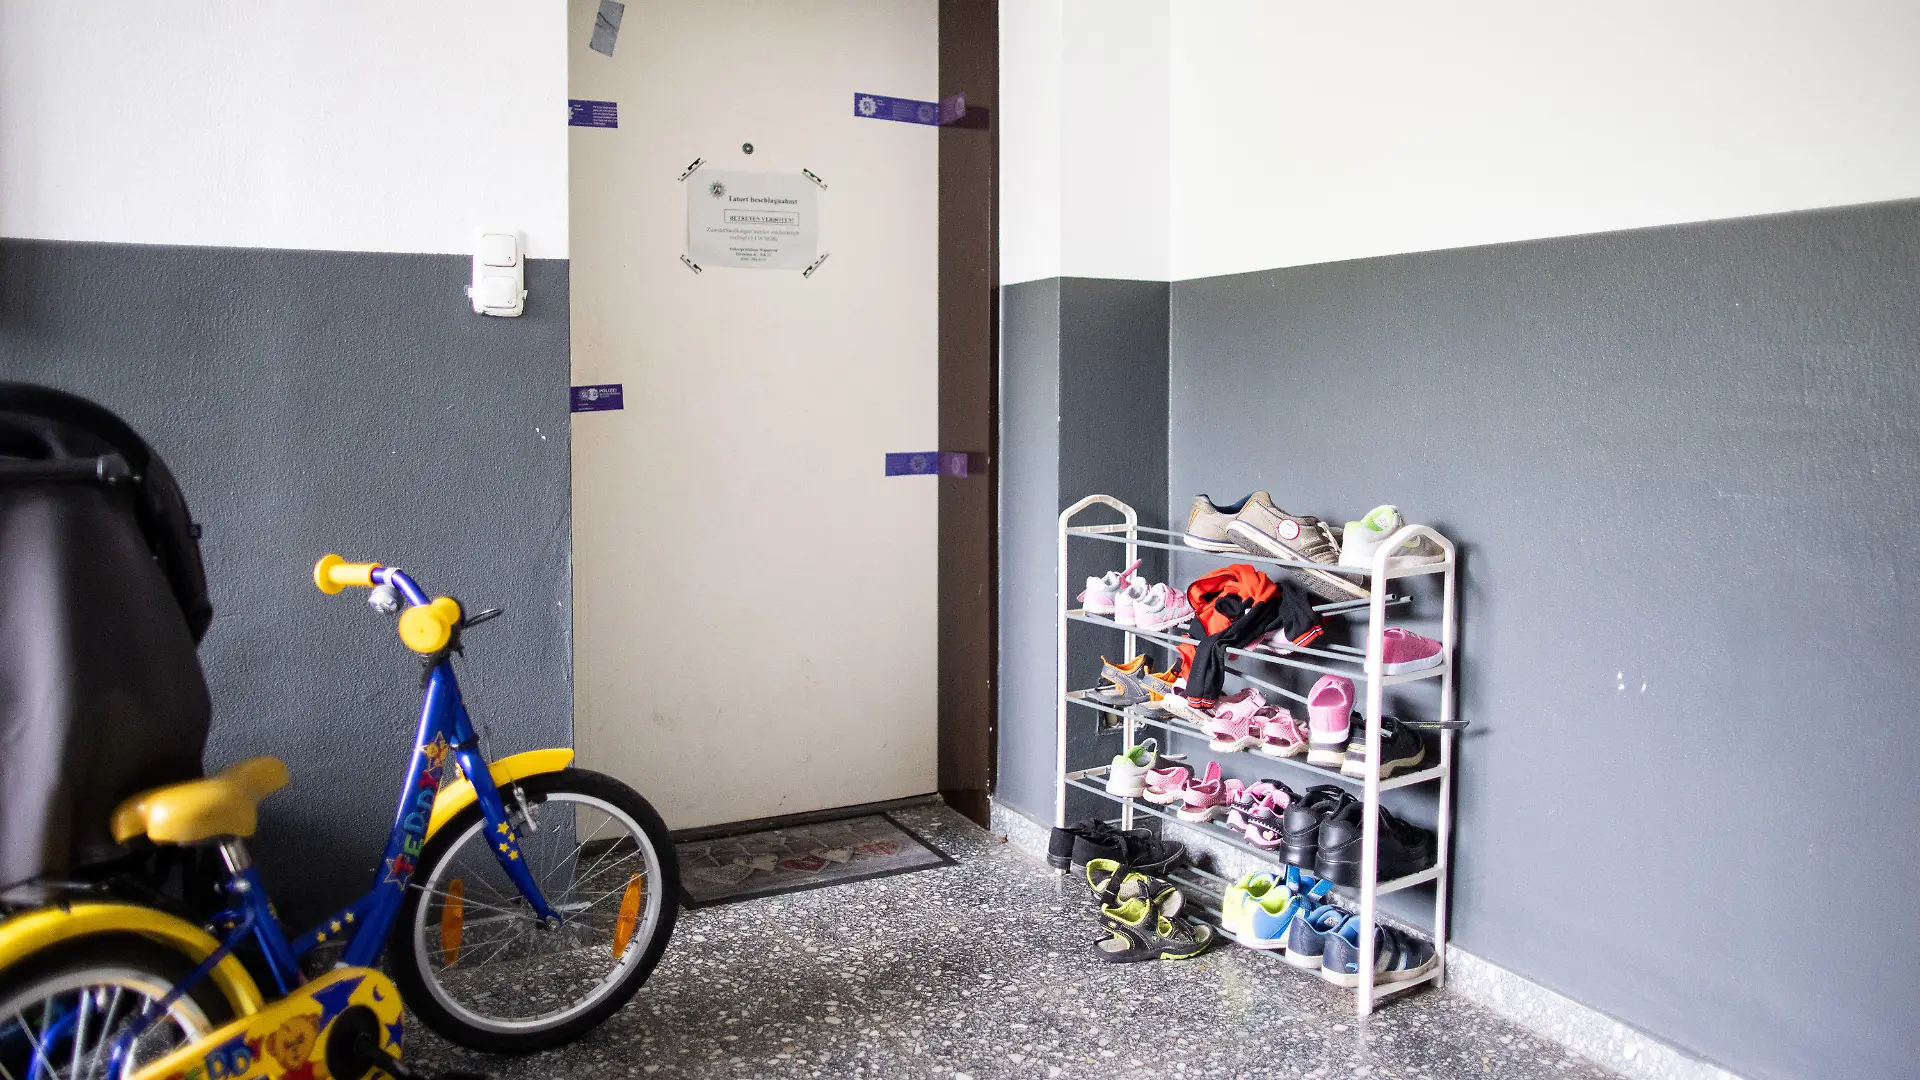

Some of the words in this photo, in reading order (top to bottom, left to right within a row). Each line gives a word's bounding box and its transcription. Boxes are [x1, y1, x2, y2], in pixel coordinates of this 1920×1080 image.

[729, 195, 749, 203] Tatort
[750, 196, 798, 206] beschlagnahmt
[392, 769, 440, 875] TEDDY
